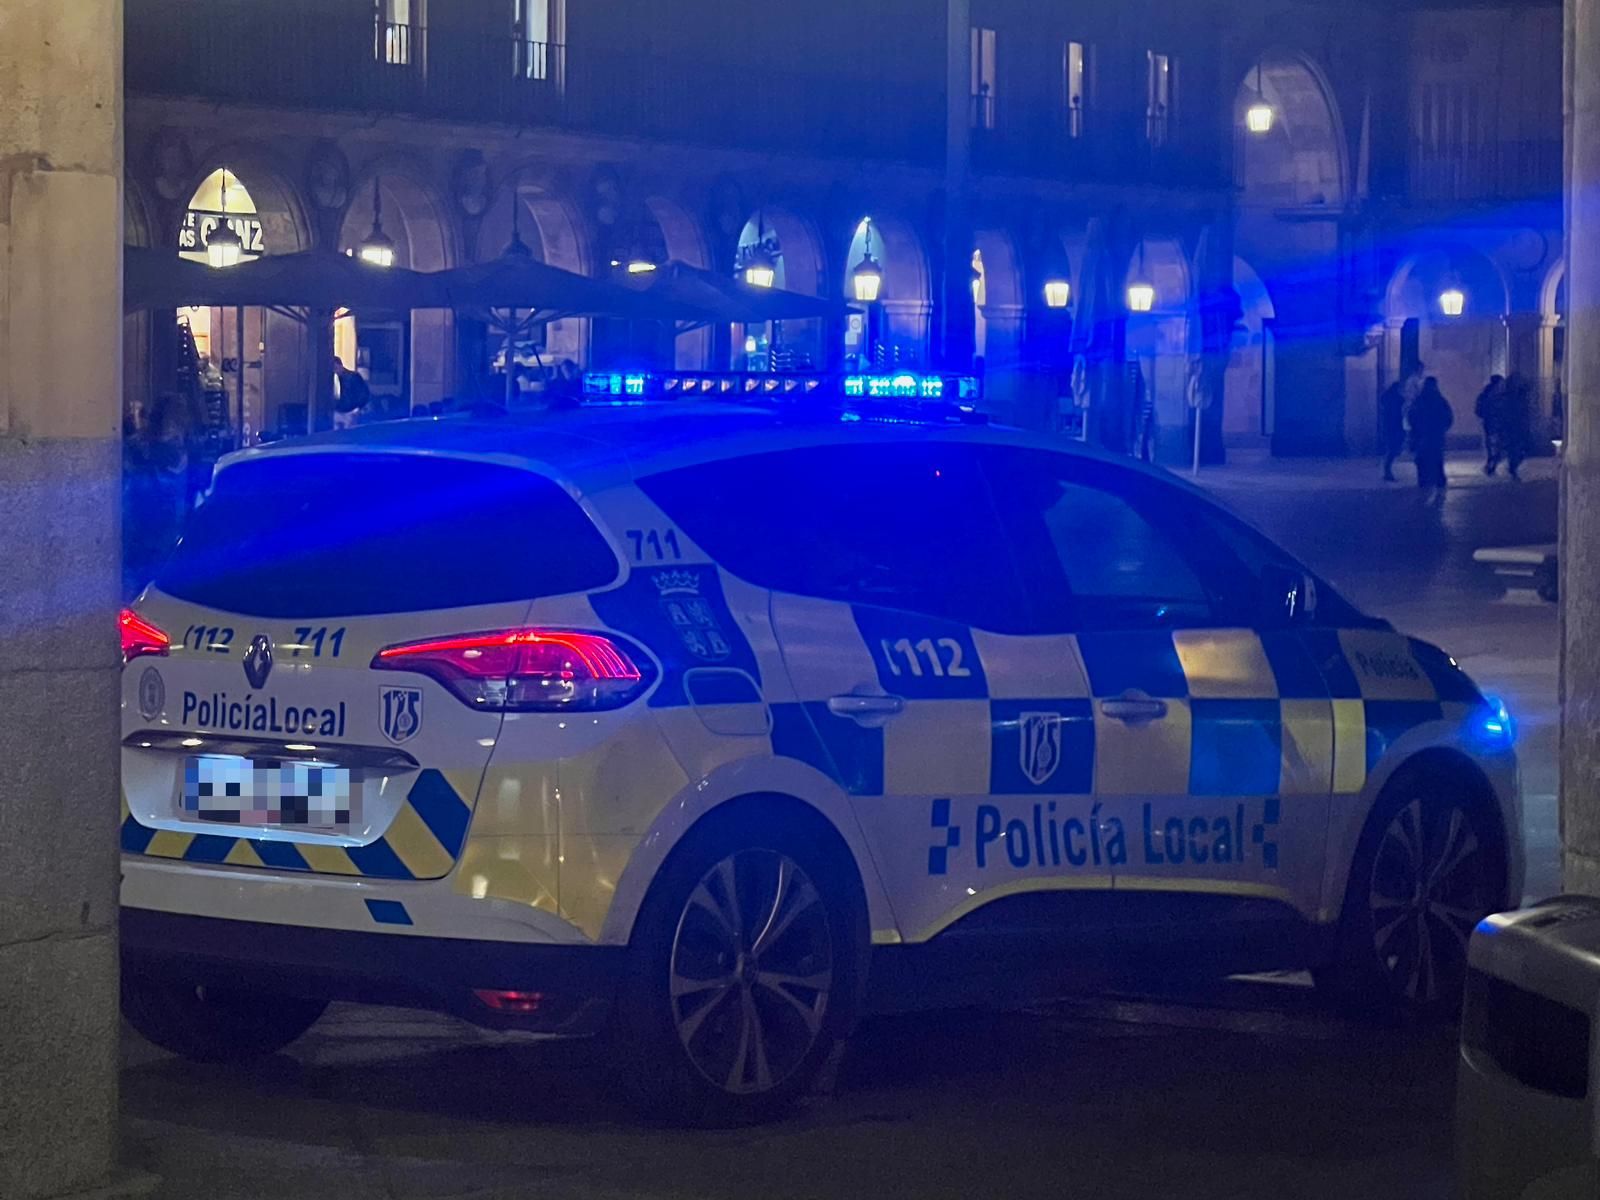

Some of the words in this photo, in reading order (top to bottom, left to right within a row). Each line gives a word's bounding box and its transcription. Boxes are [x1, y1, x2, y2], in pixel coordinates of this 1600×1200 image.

[626, 529, 681, 560] 711
[293, 627, 346, 657] 711
[976, 801, 1127, 868] Policía
[1143, 802, 1244, 865] Local
